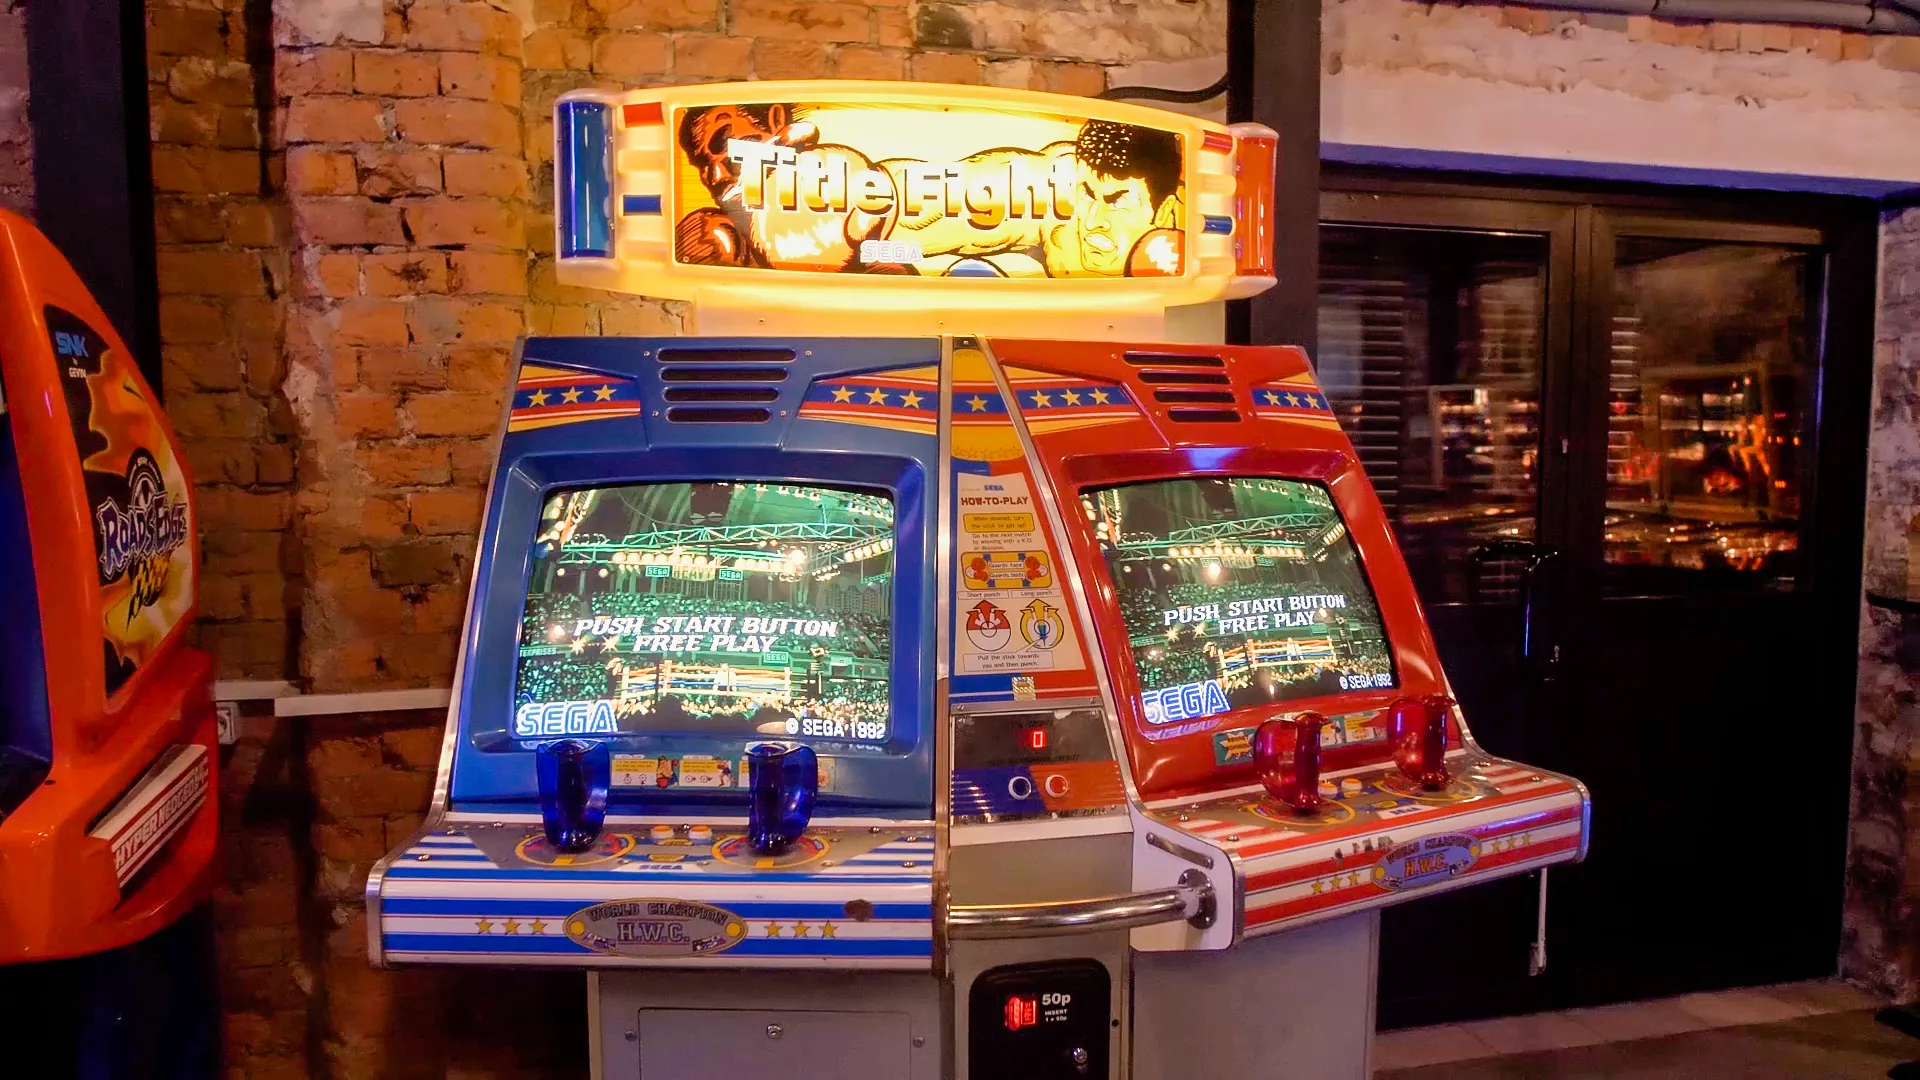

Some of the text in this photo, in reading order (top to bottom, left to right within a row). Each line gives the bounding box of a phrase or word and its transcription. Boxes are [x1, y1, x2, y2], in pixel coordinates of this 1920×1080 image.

[728, 138, 1077, 231] Title Fight
[860, 241, 923, 264] SEGA
[55, 331, 89, 357] SNK
[647, 567, 668, 575] SEGA
[721, 570, 741, 579] SEGA
[1163, 594, 1346, 626] PUSH START BUTTON
[573, 616, 837, 638] PUSH START BUTTON
[1219, 610, 1317, 635] FREE PLAY
[633, 634, 780, 653] FREE PLAY
[766, 653, 786, 661] SEGA
[1348, 675, 1372, 689] SEGA
[1141, 680, 1231, 724] SEGA
[516, 700, 619, 738] SEGA
[802, 718, 845, 737] SEGA
[115, 813, 158, 870] HYPER
[586, 902, 729, 926] WORLD CHAMPION
[617, 921, 690, 942] H.W.C.
[1042, 992, 1071, 1006] 50p
[1045, 1008, 1068, 1016] INSERT
